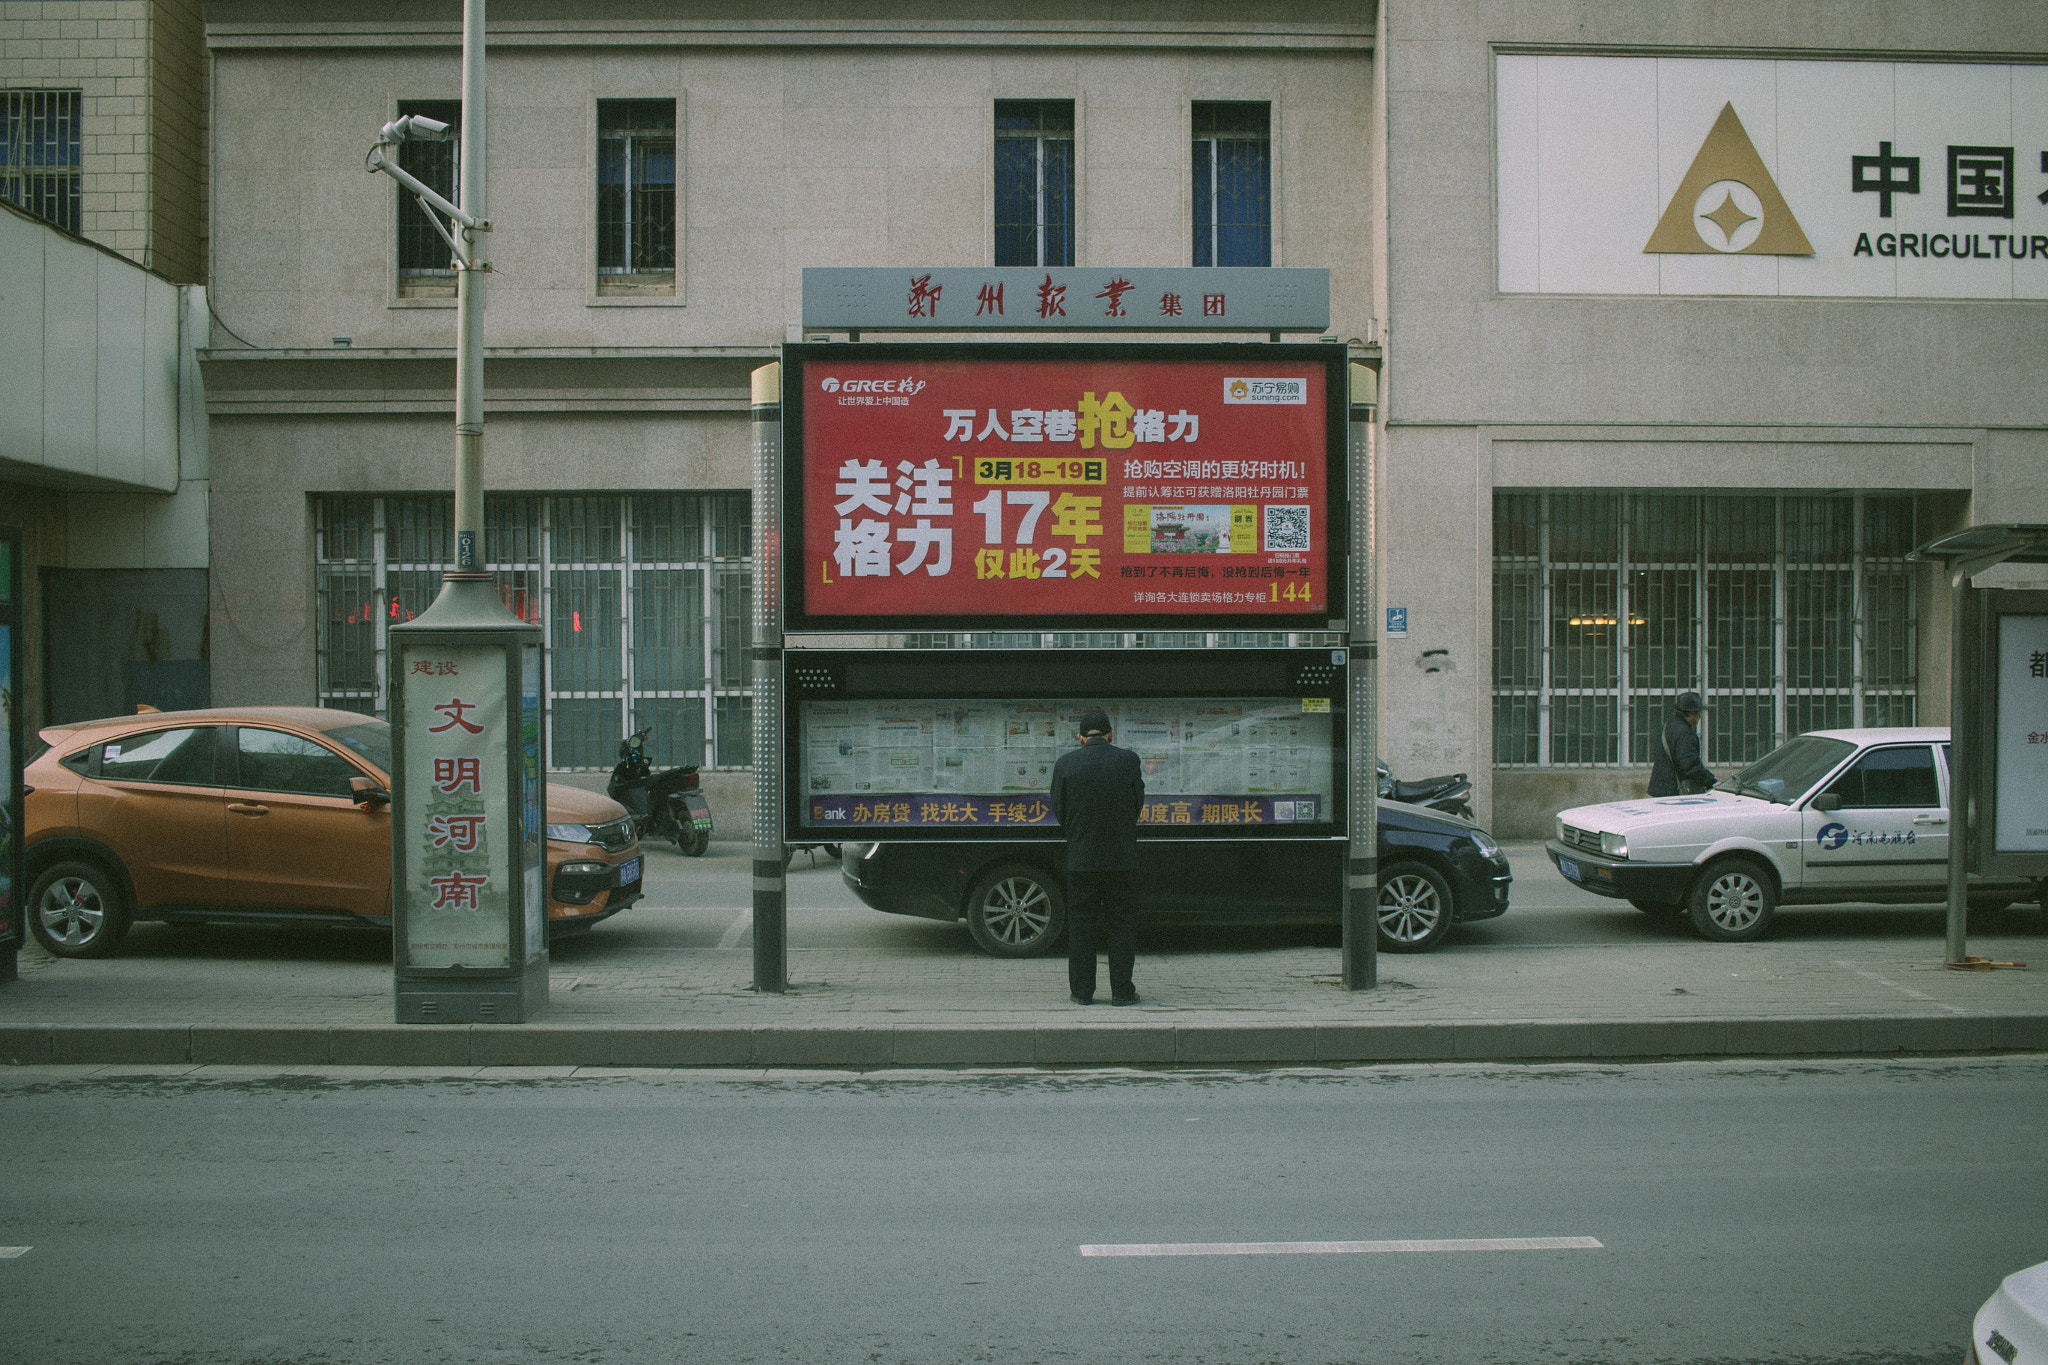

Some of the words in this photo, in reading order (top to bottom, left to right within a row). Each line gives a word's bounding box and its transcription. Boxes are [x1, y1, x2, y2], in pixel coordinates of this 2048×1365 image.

[843, 380, 896, 393] GREE
[1251, 382, 1300, 395] 苏宁易购
[838, 396, 910, 406] 让世界爱上中国造
[942, 391, 1200, 449] 万人空巷抢格力
[833, 458, 954, 517] 关注
[973, 489, 1104, 545] 17年
[461, 538, 472, 566] 0126
[833, 519, 953, 577] 格力
[973, 548, 1102, 580] 仅此2天
[1269, 581, 1312, 603] 144
[411, 661, 460, 676] 建设
[429, 698, 487, 911] 文明河南
[852, 804, 911, 823] 办房贷
[921, 803, 979, 823] 找光大
[988, 801, 1050, 823] 手续少
[1201, 801, 1263, 823] 期限长
